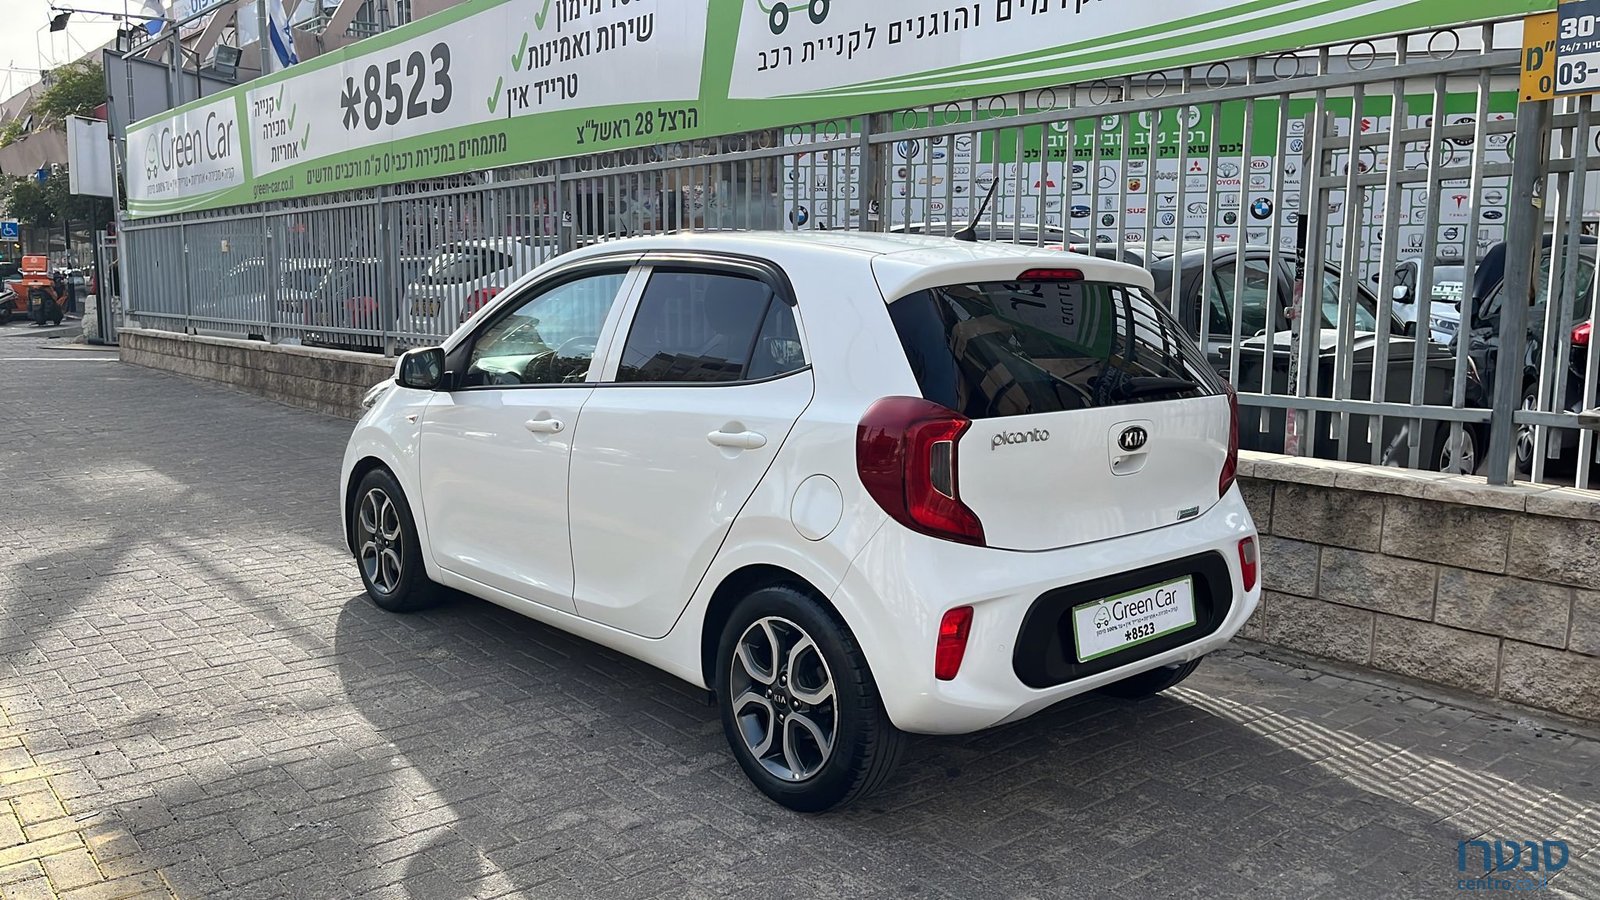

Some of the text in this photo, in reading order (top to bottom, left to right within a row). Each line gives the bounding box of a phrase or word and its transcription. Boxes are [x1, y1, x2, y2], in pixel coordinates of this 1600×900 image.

[888, 4, 980, 45] והוגנים
[527, 13, 654, 71] שירות ואמינות
[801, 23, 877, 60] לקניית
[1560, 42, 1581, 53] 24/7
[757, 46, 792, 72] רכב
[254, 96, 275, 118] קנייה
[506, 73, 579, 118] טרייד אין
[263, 119, 286, 139] מכירה
[635, 110, 654, 136] 28
[657, 107, 698, 132] הרצל
[161, 111, 233, 172] Green Car
[271, 141, 299, 163] אחריות
[306, 132, 507, 184] מתמחים במכירת רכבי 0 ק"מ ורכבים חדשים
[253, 175, 294, 199] green-car.co.il
[991, 428, 1050, 451] picanto
[1124, 430, 1147, 447] KIA
[1112, 589, 1177, 621] Green Car
[773, 694, 787, 704] KIA
